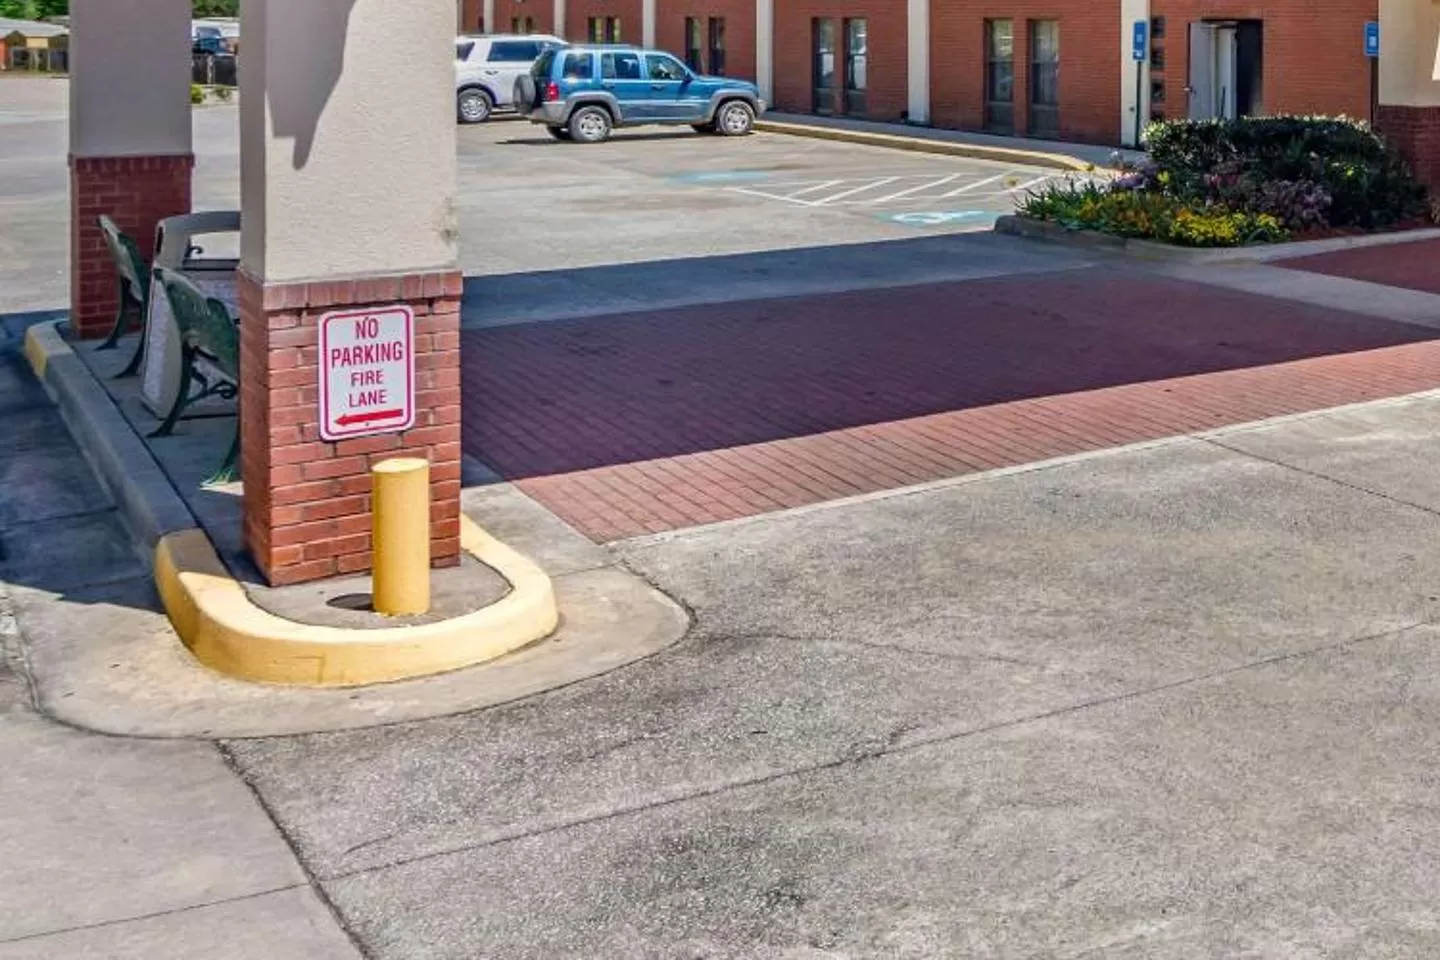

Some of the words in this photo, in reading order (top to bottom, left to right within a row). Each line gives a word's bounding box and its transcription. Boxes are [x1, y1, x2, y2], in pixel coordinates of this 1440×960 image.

[354, 317, 380, 339] NO
[331, 341, 403, 369] PARKING
[350, 369, 384, 387] FIRE
[348, 389, 387, 408] LANE
